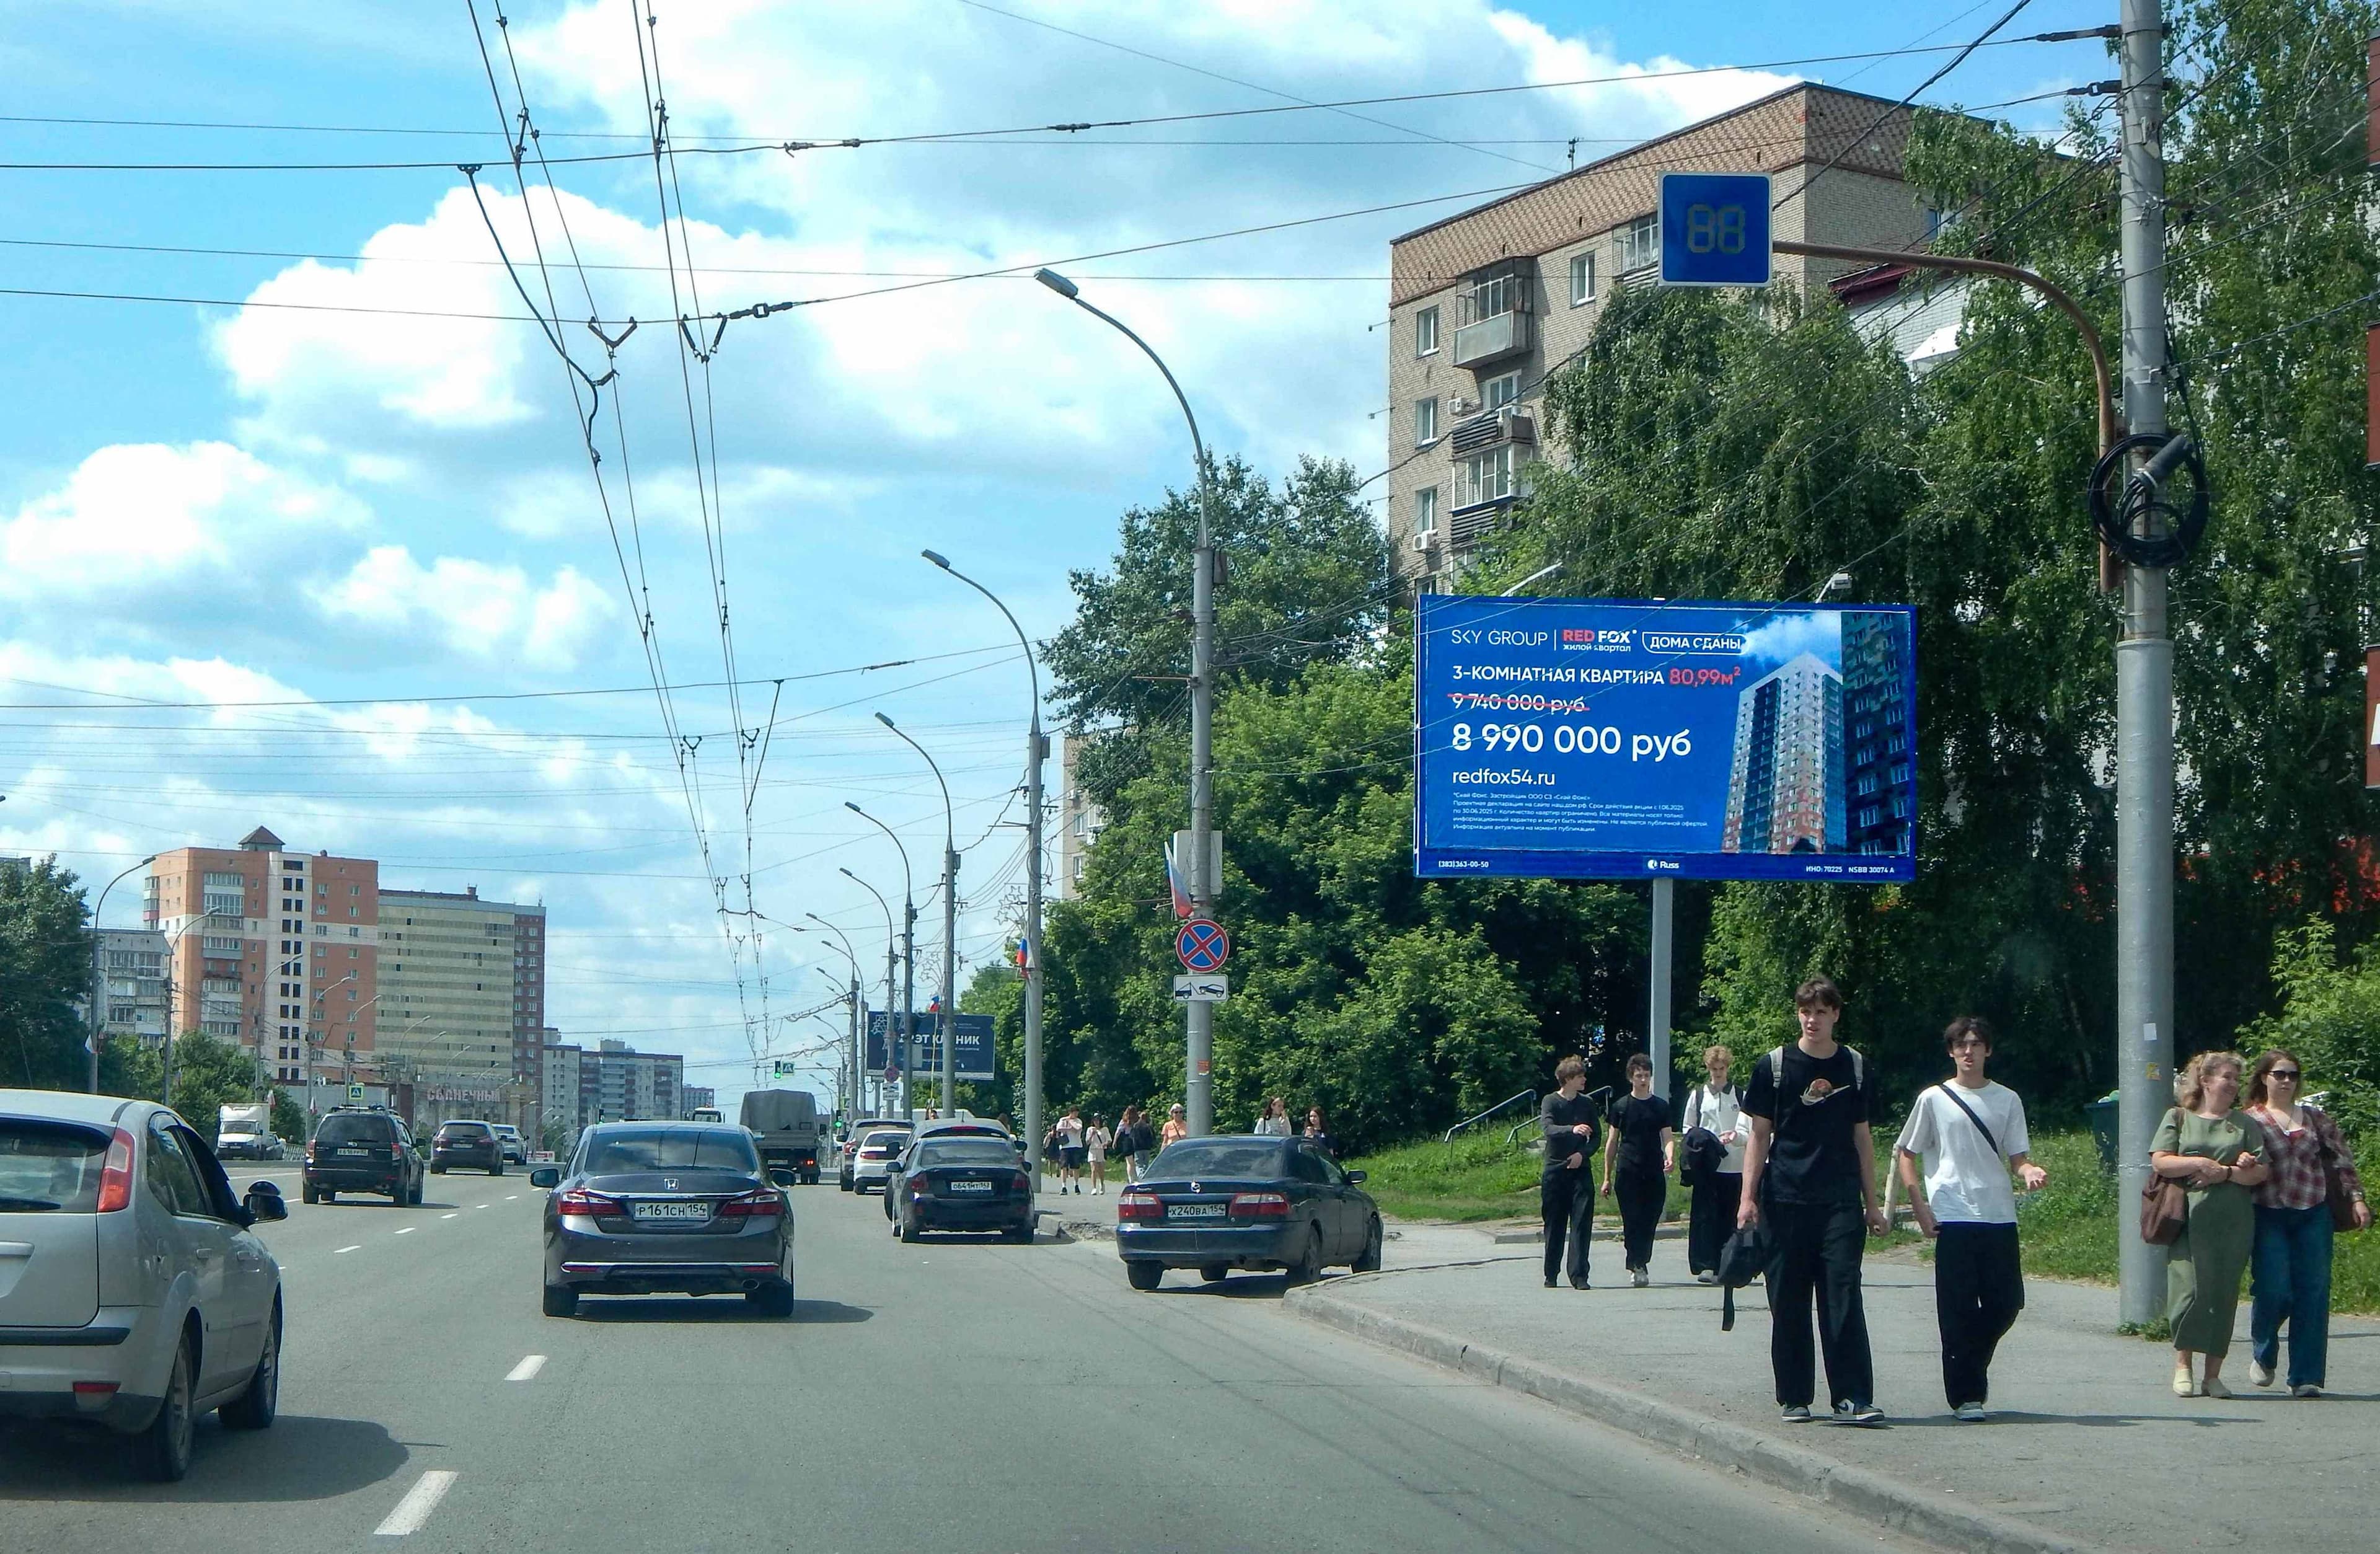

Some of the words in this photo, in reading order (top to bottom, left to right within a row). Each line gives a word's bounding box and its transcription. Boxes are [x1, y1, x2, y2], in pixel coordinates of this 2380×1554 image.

[1452, 629, 1482, 644] SKY
[1488, 630, 1548, 646] GROUP
[1562, 629, 1595, 642] RED
[1598, 630, 1631, 643] FOX
[1562, 643, 1592, 651] жилой
[1650, 637, 1690, 650] ДОМА
[1693, 637, 1741, 650] СДАНЫ
[1452, 665, 1576, 682] 3-КОМНАТНАЯ
[1580, 668, 1665, 684] КВАРТИРА
[1452, 693, 1463, 709] 9
[1469, 693, 1501, 710] 740
[1507, 694, 1545, 711] 000
[1452, 723, 1471, 751] 8
[1481, 723, 1544, 753] 990
[1554, 725, 1621, 754] 000
[1632, 728, 1691, 762] руб
[1452, 768, 1556, 786] redfox54.ru
[1660, 860, 1680, 869] Russ
[932, 1035, 980, 1045] КЛНИК
[639, 1204, 685, 1216] Р161СН
[687, 1204, 705, 1213] 154
[1171, 1206, 1207, 1216] Х240ВА
